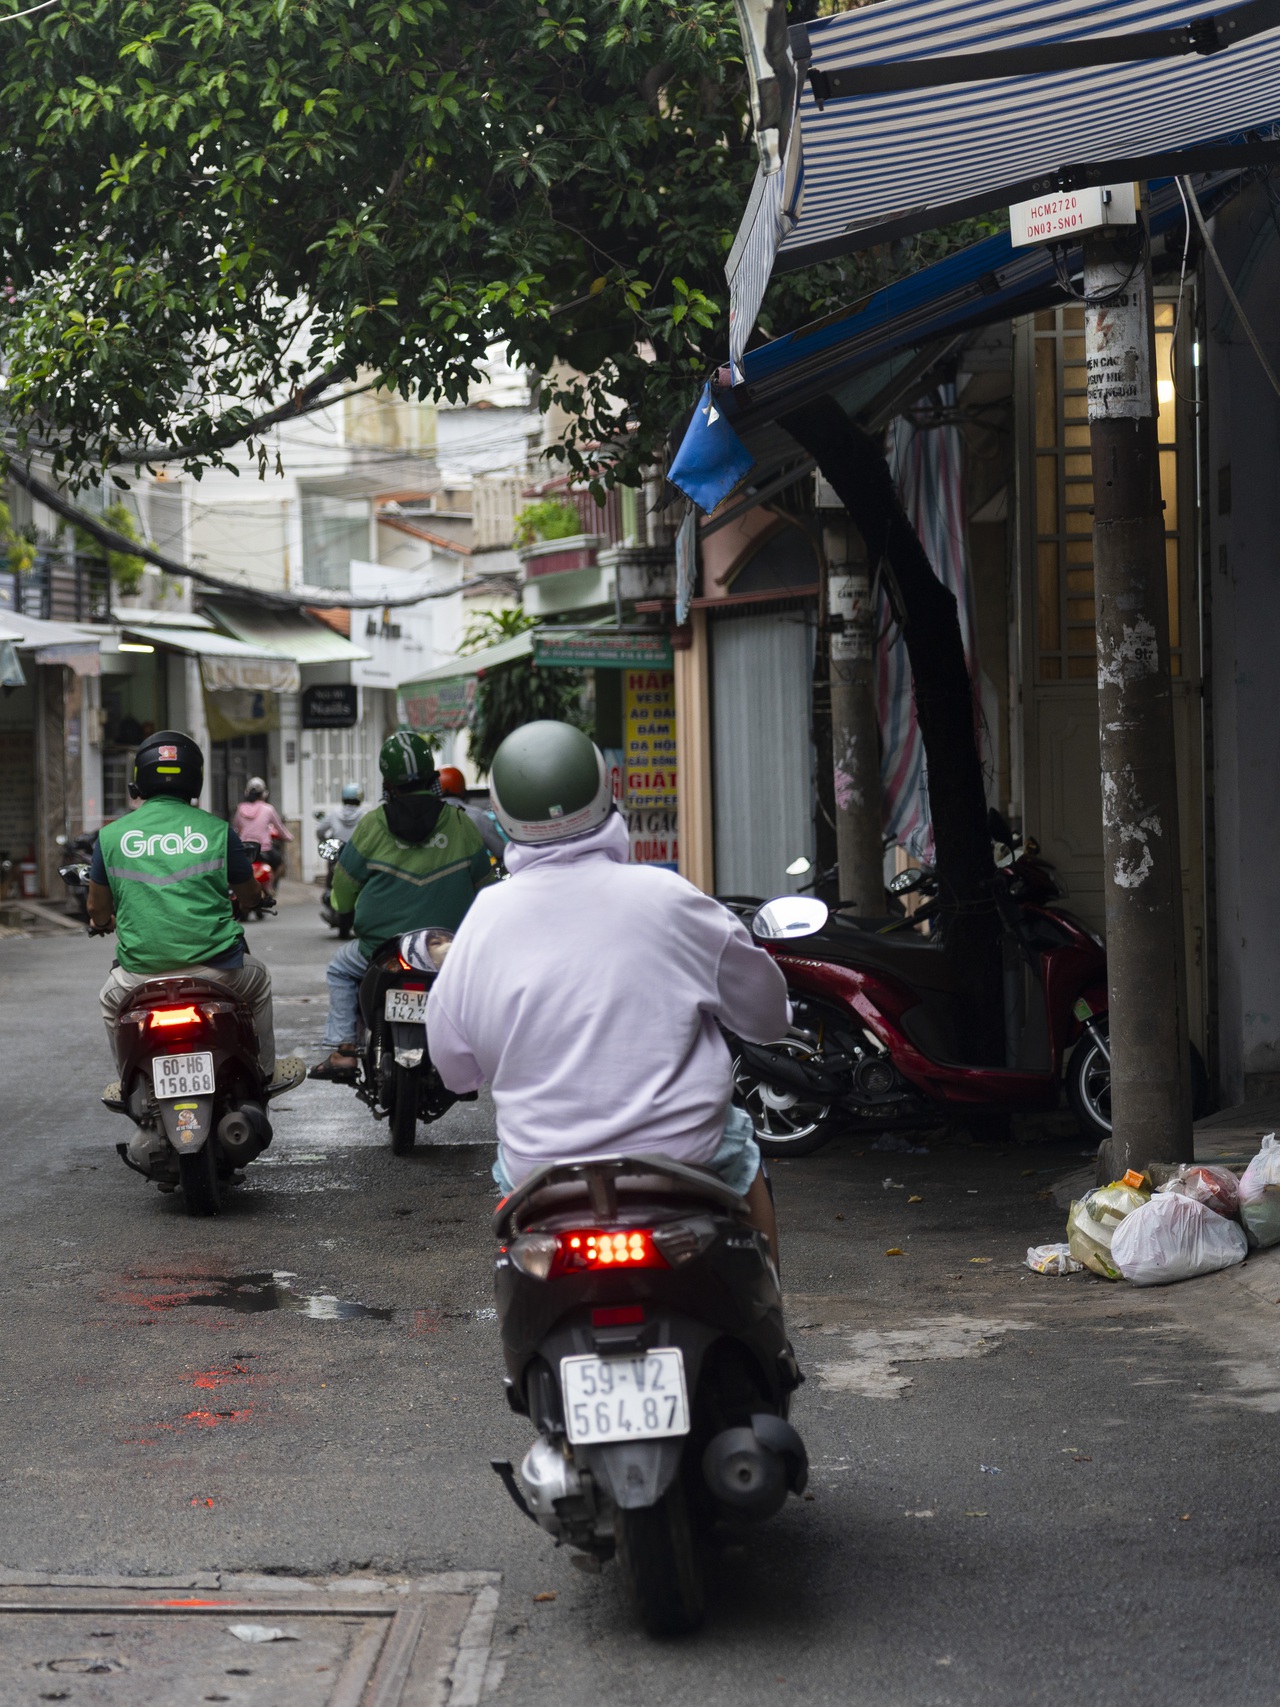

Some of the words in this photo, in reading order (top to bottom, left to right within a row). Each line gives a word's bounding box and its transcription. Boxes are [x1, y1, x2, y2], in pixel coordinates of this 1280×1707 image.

[1031, 197, 1077, 219] HCM2720
[1027, 213, 1083, 237] DN03-SN01
[120, 826, 208, 858] Grab
[394, 992, 428, 1007] 59-V
[163, 1056, 204, 1076] 60-H6
[160, 1074, 211, 1095] 158.68
[581, 1358, 665, 1397] 59-V2
[573, 1395, 678, 1437] 564.87
